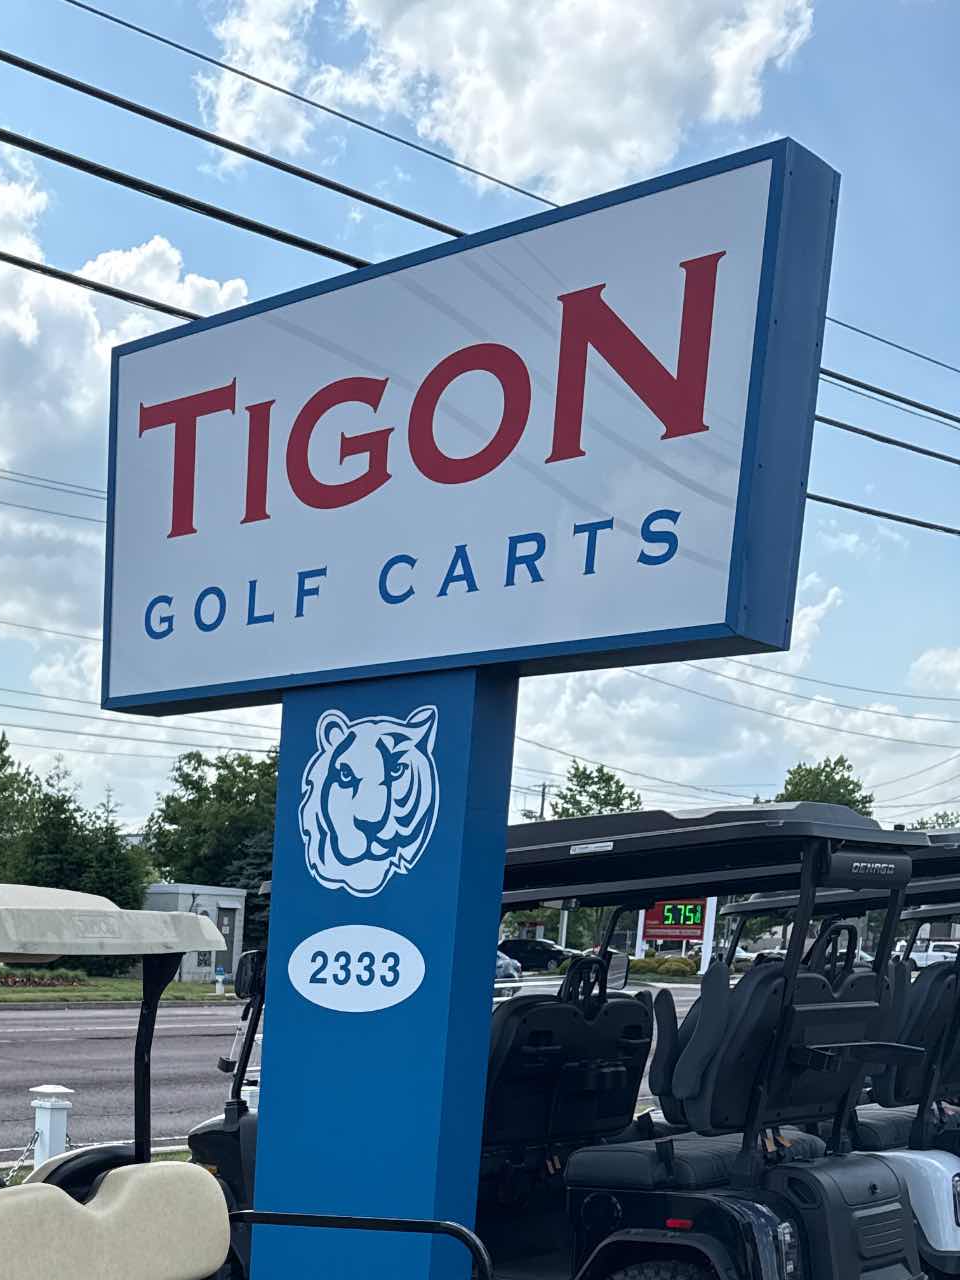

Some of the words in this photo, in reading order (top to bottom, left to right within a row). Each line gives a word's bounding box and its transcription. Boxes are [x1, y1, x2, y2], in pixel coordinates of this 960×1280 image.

[138, 250, 727, 538] TIGON
[143, 567, 328, 641] GOLF
[378, 508, 682, 606] CARTS
[308, 950, 401, 988] 2333
